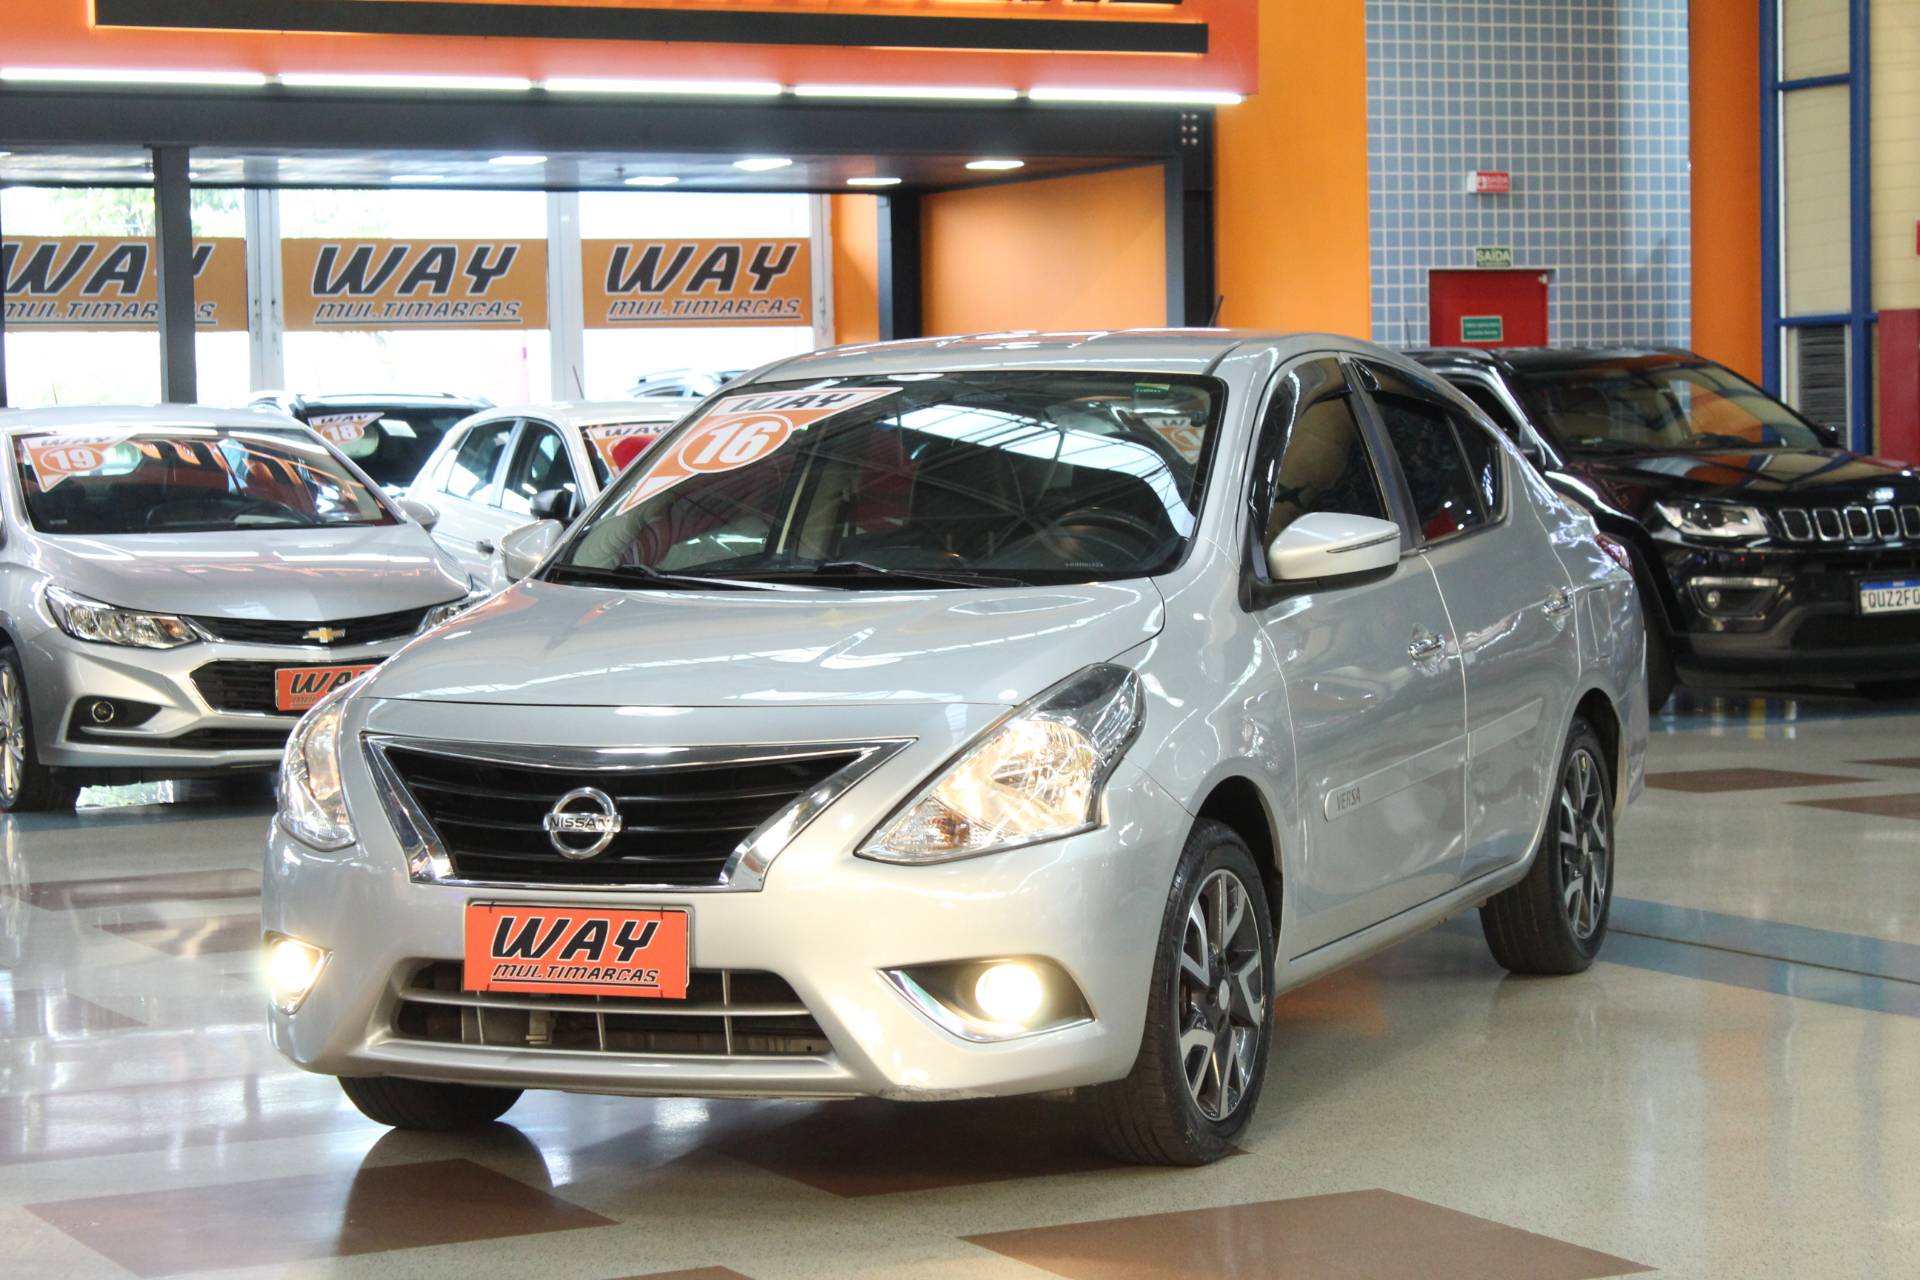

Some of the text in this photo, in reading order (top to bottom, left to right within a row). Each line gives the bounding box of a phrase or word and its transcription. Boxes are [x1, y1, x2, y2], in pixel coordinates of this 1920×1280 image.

[311, 244, 521, 297] WAY
[605, 243, 800, 295] WAY
[315, 302, 522, 319] MULTIMARCAS
[608, 299, 801, 316] MULTIMARCAS
[730, 392, 850, 412] WAY
[325, 424, 358, 442] 18
[692, 420, 782, 465] 16
[48, 447, 97, 470] 19
[289, 671, 367, 695] WA
[549, 816, 610, 829] NISSAN
[491, 915, 661, 963] WAY
[492, 963, 660, 983] MULTIMARCAS
